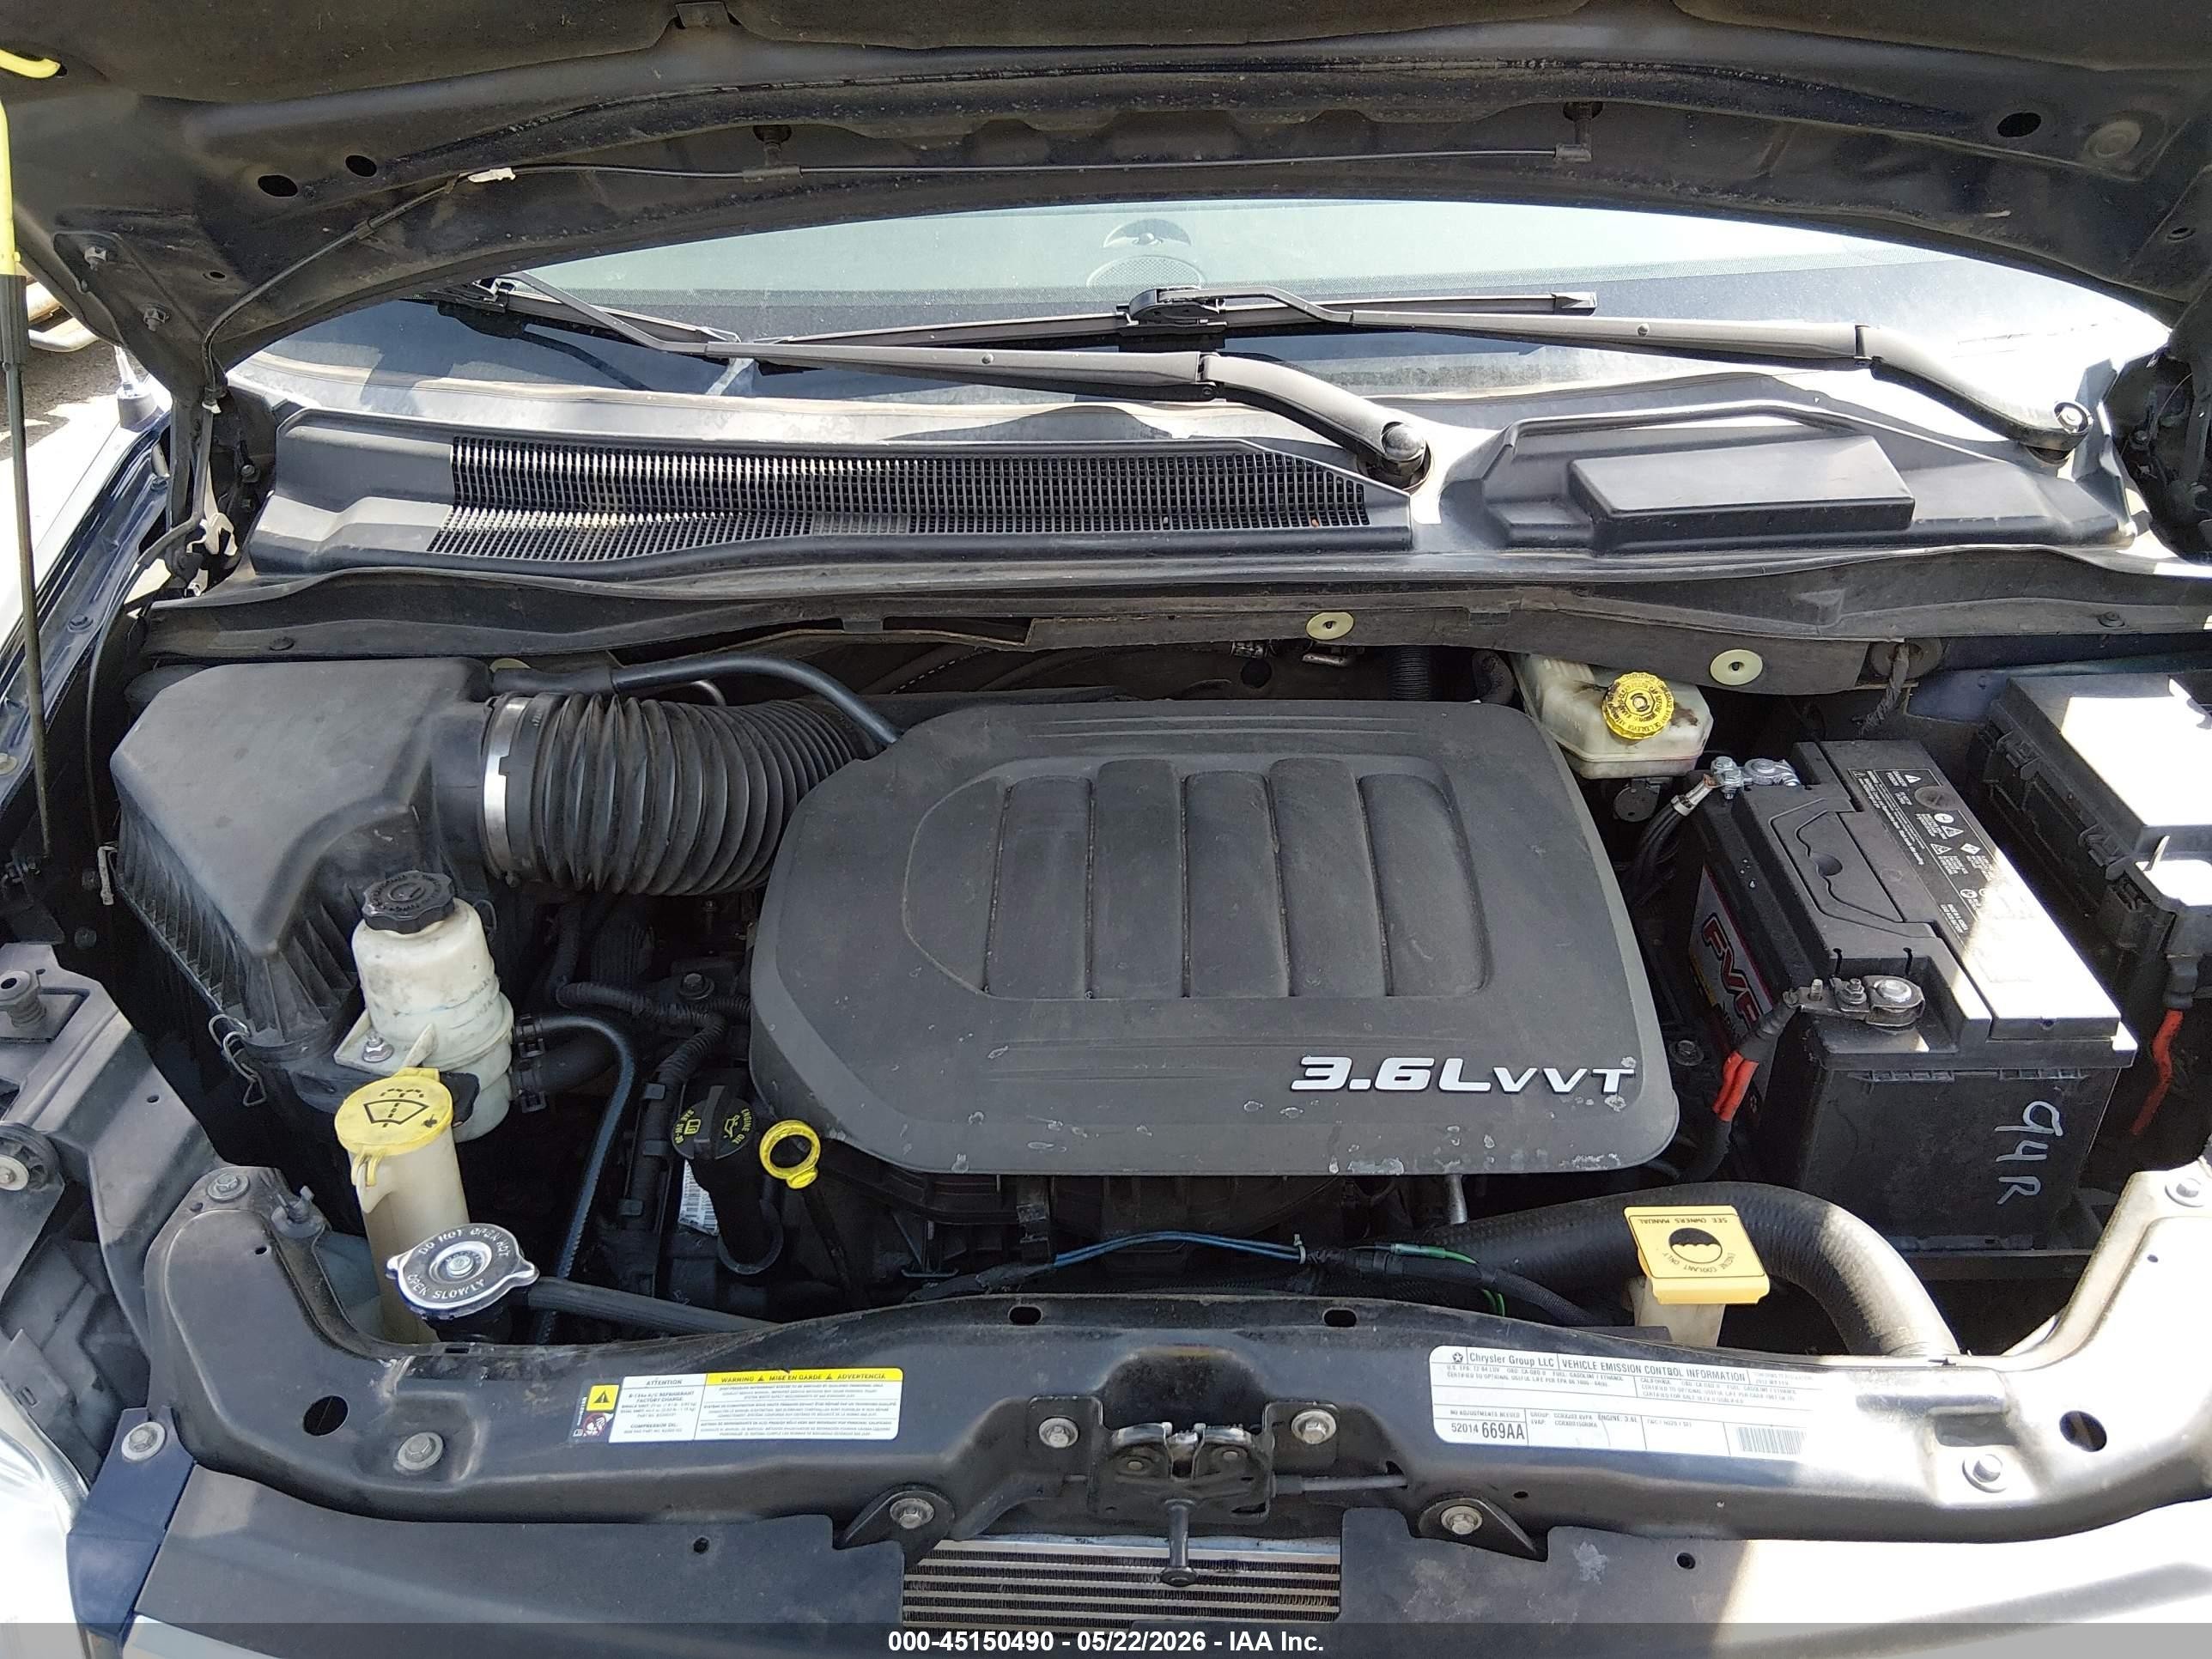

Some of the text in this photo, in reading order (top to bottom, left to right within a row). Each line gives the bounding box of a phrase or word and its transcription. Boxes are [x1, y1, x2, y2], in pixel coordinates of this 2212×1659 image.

[732, 1109, 752, 1144] ENGINE OIL
[418, 1242, 435, 1255] DO
[438, 1230, 464, 1242] NOT
[471, 1227, 501, 1241] OPEN
[496, 1242, 511, 1257] HOT
[1662, 1253, 1680, 1265] ONLY
[1683, 1264, 1717, 1273] COOLANT
[407, 1273, 486, 1299] OPEN SLOWLY
[1469, 1352, 1505, 1364] Chrysler
[1509, 1355, 1535, 1367] Group
[1538, 1358, 1554, 1367] LLC
[1562, 1359, 1597, 1370] VEHICLE
[1601, 1362, 1642, 1373] EMISSION
[1686, 1369, 1746, 1382] INFORMATION
[1451, 1422, 1526, 1439] 52014 669AA
